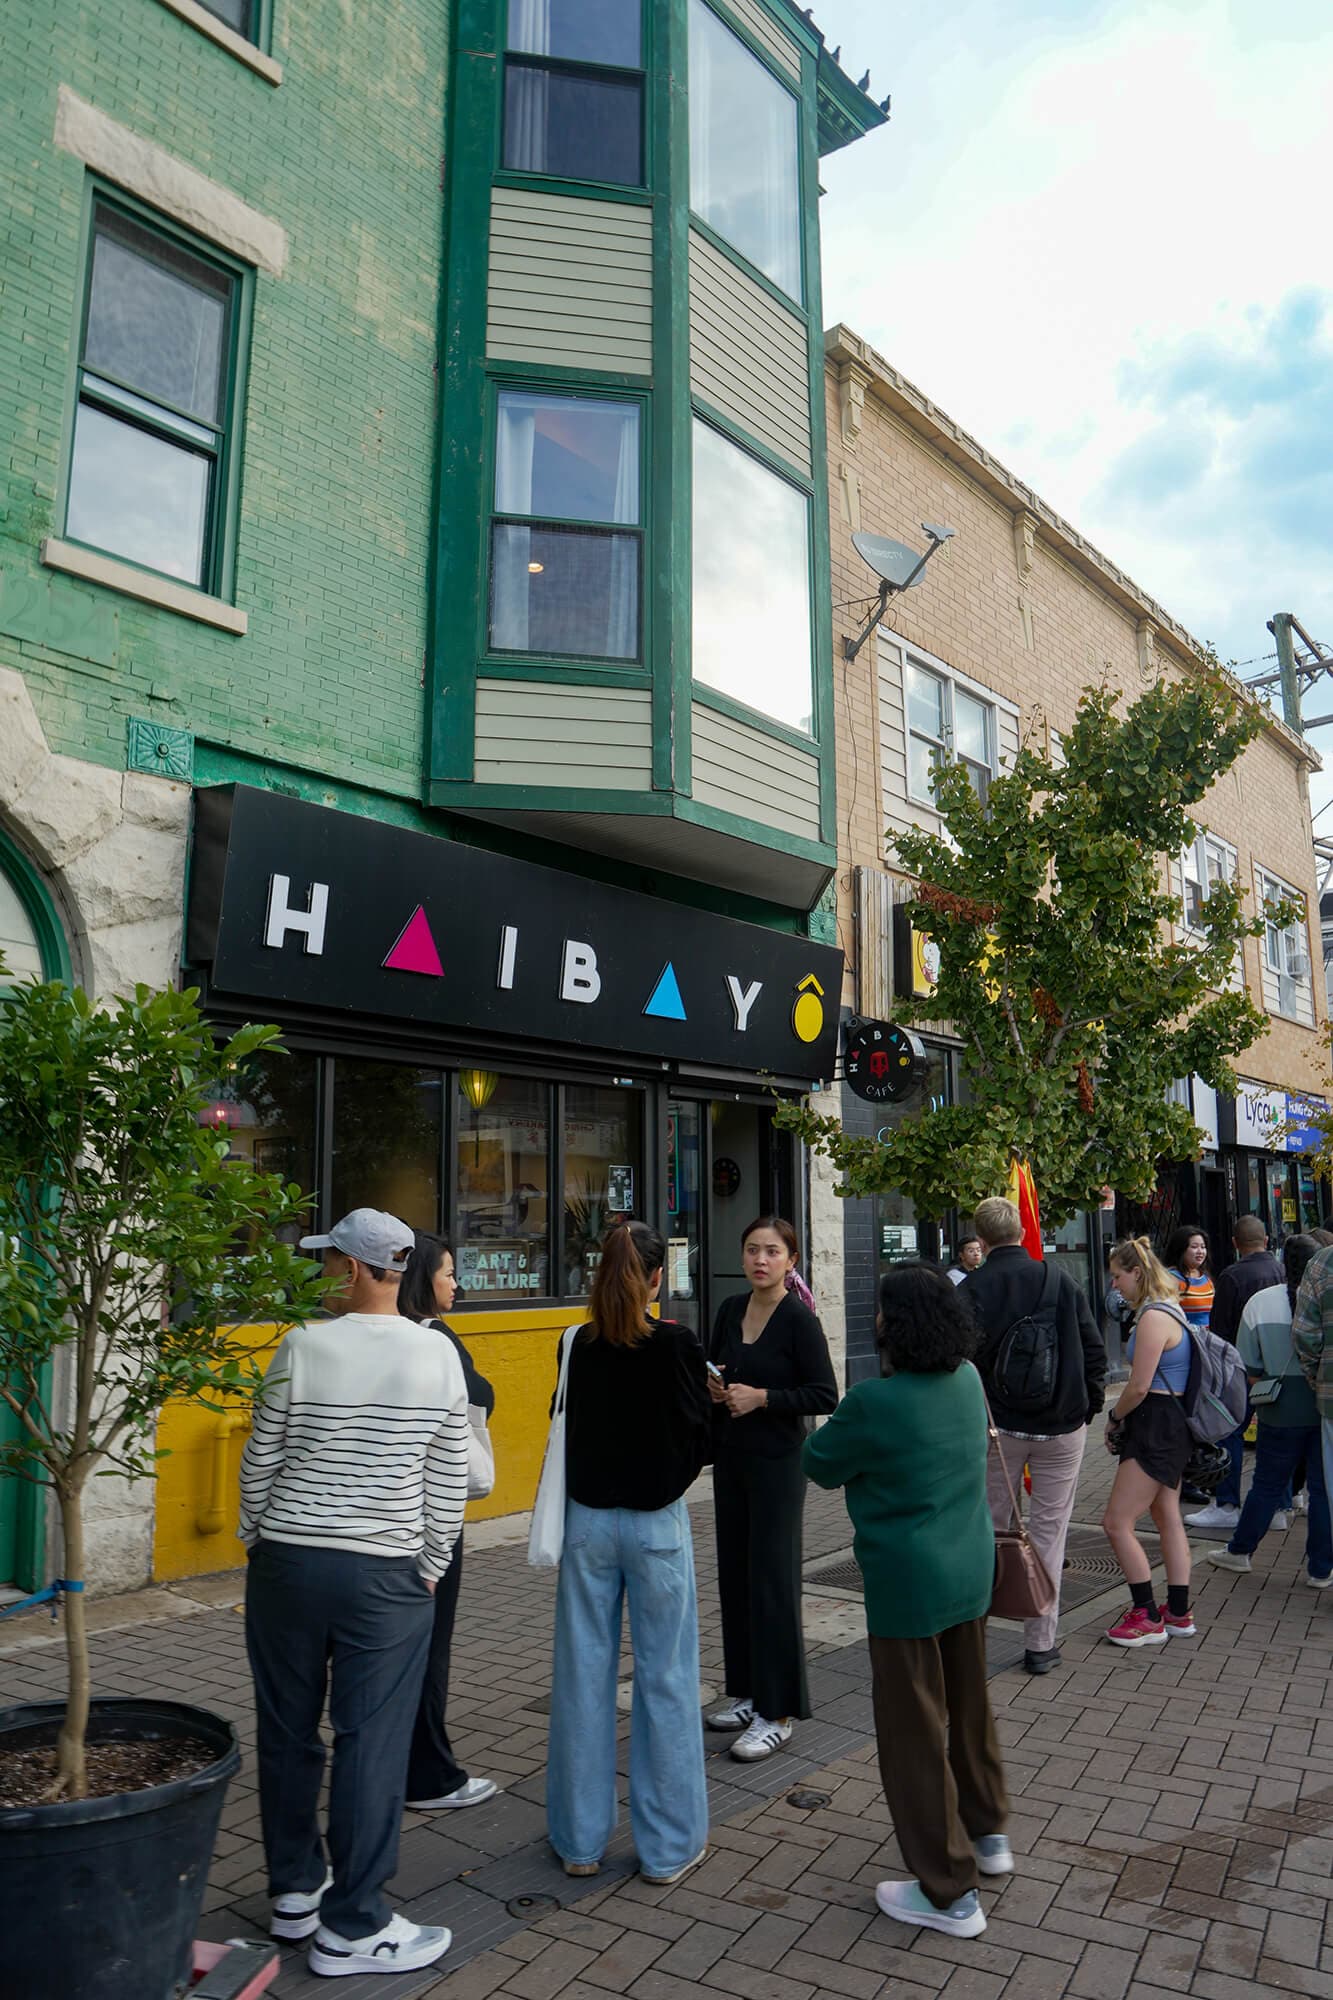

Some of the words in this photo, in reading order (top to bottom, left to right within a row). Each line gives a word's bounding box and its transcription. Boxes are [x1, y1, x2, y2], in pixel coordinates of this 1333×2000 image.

[477, 1252, 512, 1271] ART
[518, 1253, 528, 1269] &
[460, 1272, 541, 1291] CULTURE
